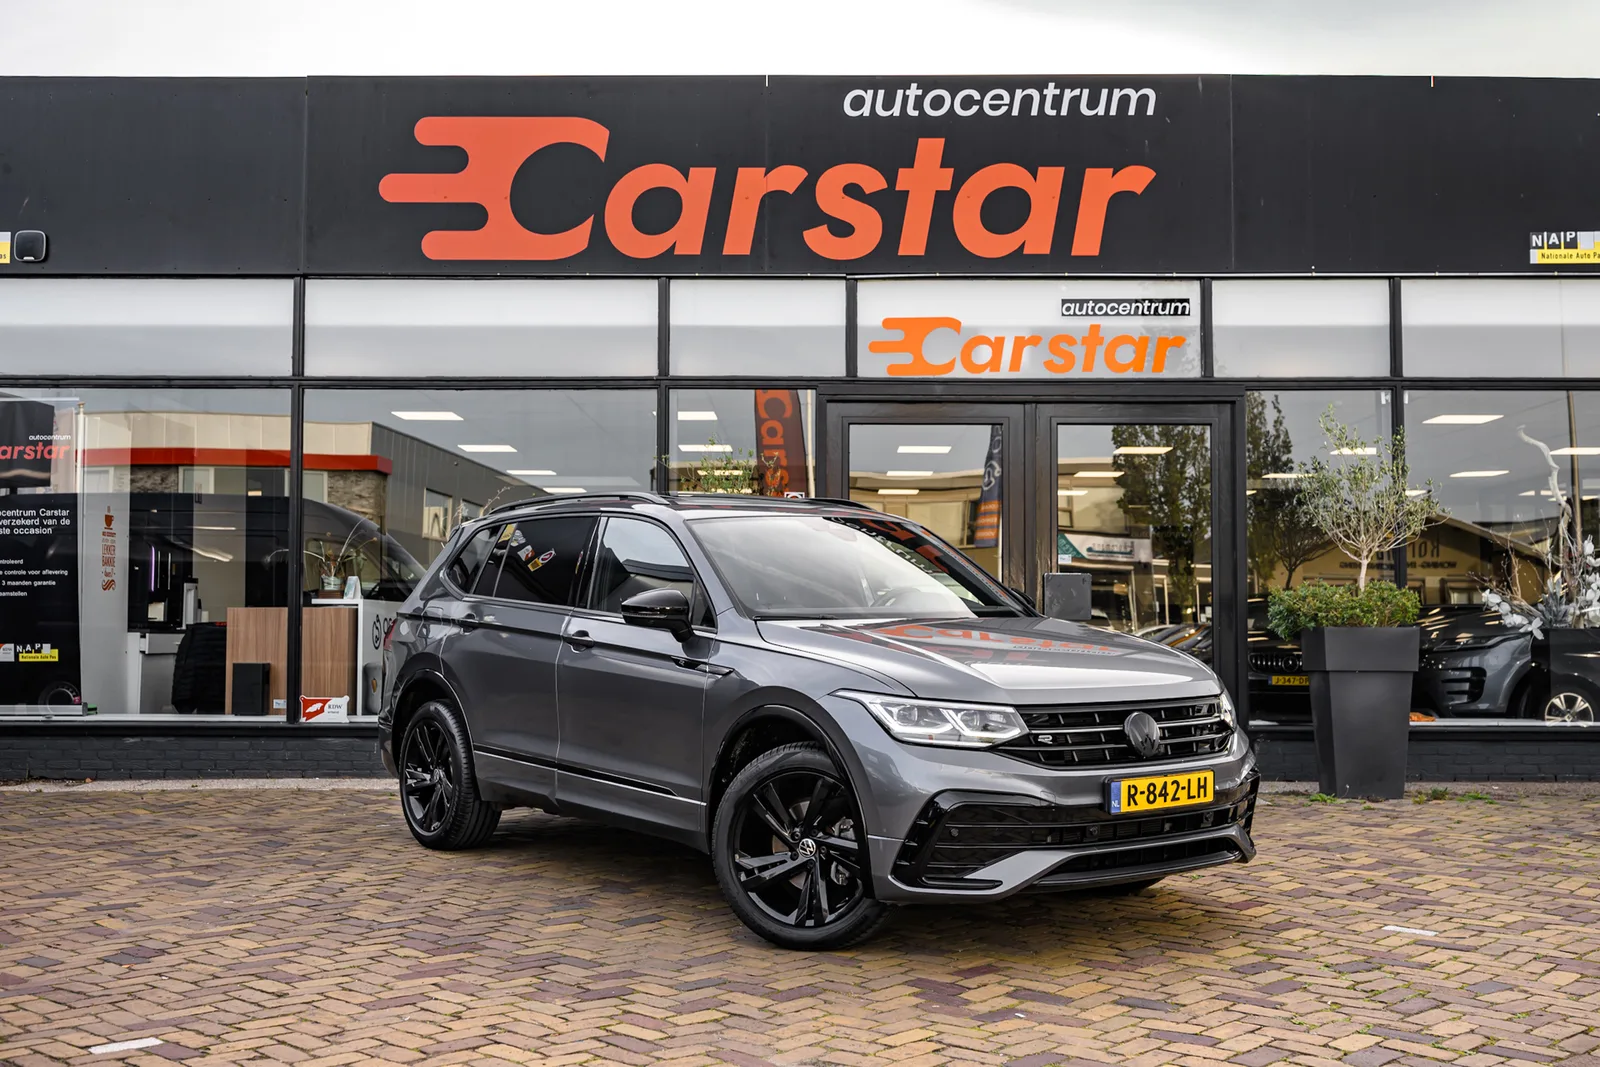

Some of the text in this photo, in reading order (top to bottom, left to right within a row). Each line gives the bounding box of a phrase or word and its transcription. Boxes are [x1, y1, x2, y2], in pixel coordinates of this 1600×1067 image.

[843, 81, 1157, 118] autocentrum
[378, 116, 1157, 261] Carstar
[1062, 299, 1190, 316] autocentrum
[868, 316, 1187, 375] Carstar
[39, 508, 70, 516] Carstar
[1112, 776, 1208, 808] NL R-842-LH
